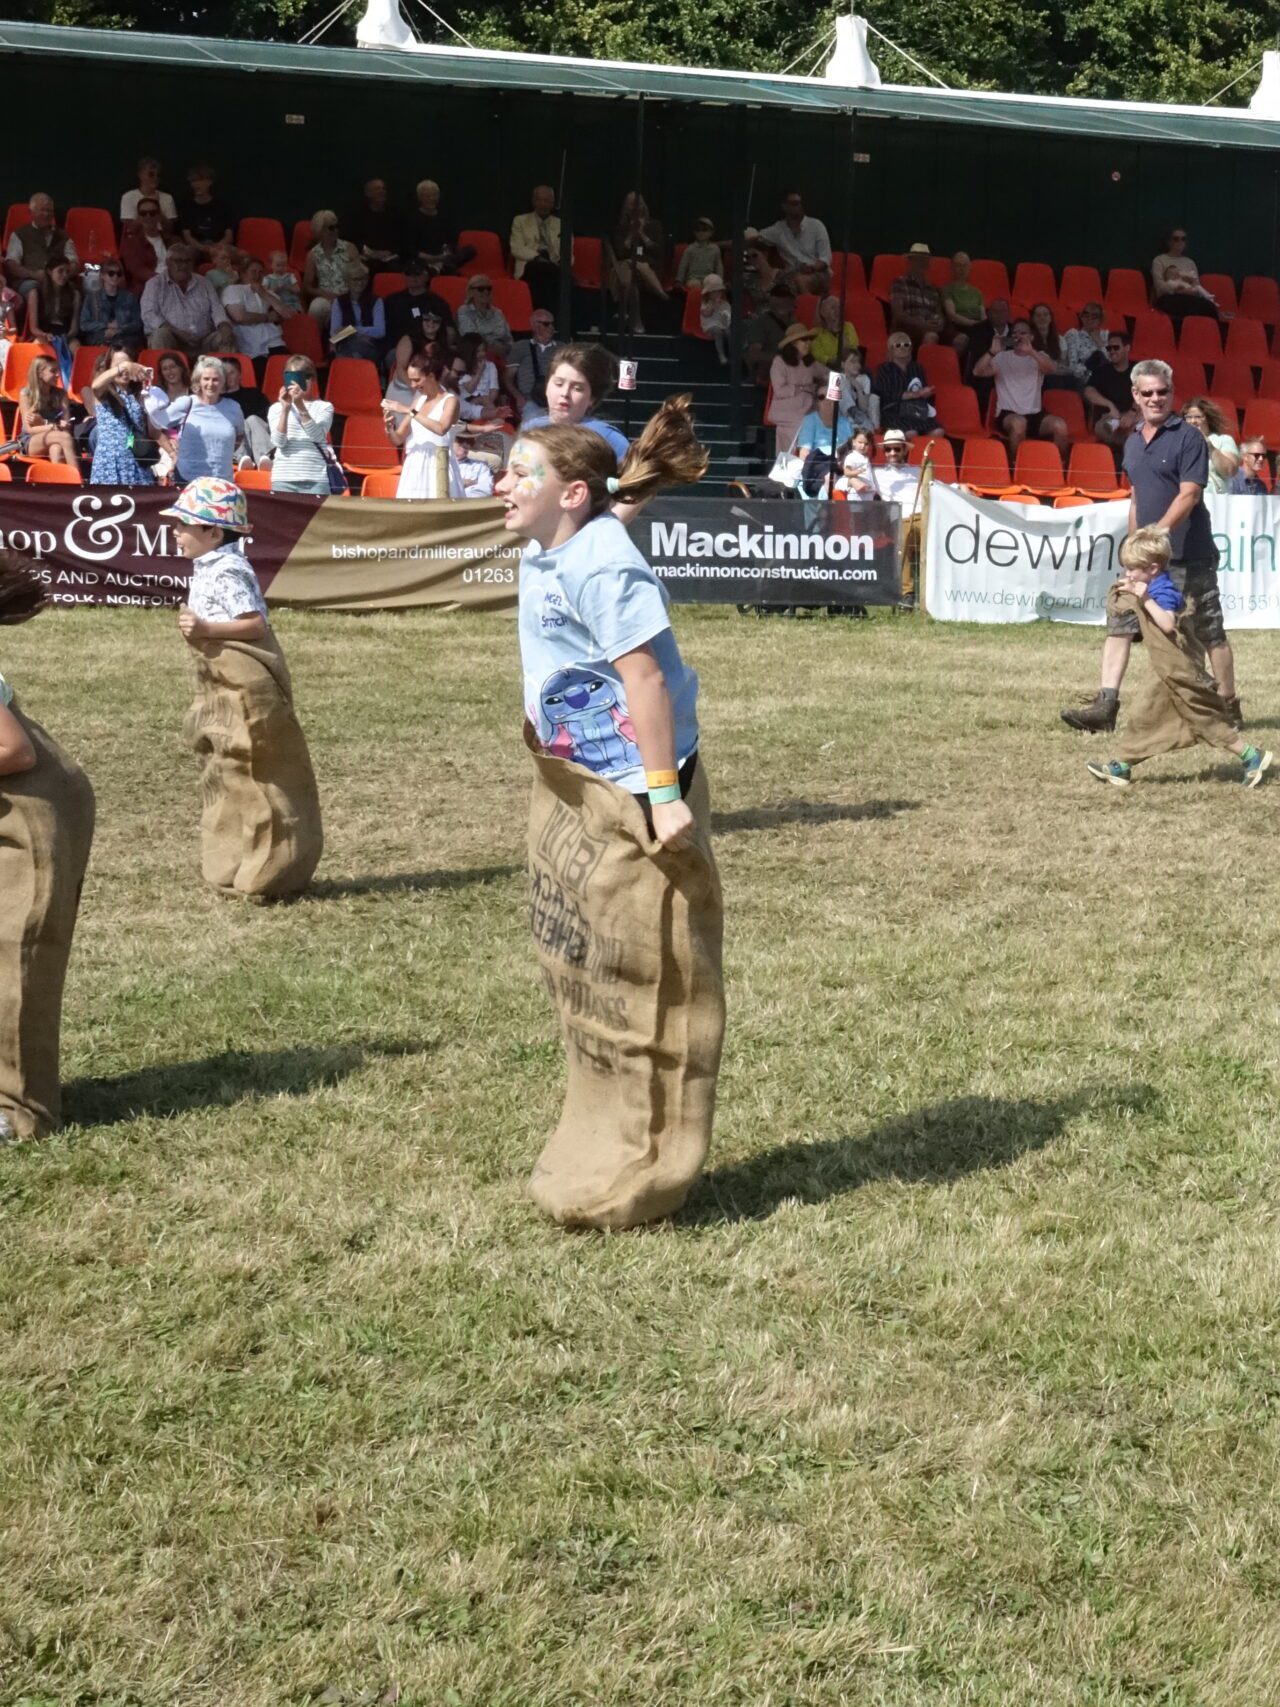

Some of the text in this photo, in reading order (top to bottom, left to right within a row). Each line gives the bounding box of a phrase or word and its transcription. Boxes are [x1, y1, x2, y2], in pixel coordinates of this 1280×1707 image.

[651, 522, 874, 561] Mackinnon
[56, 570, 99, 585] AND
[462, 567, 514, 583] 01263
[652, 563, 878, 581] mackinnonconstruction.com
